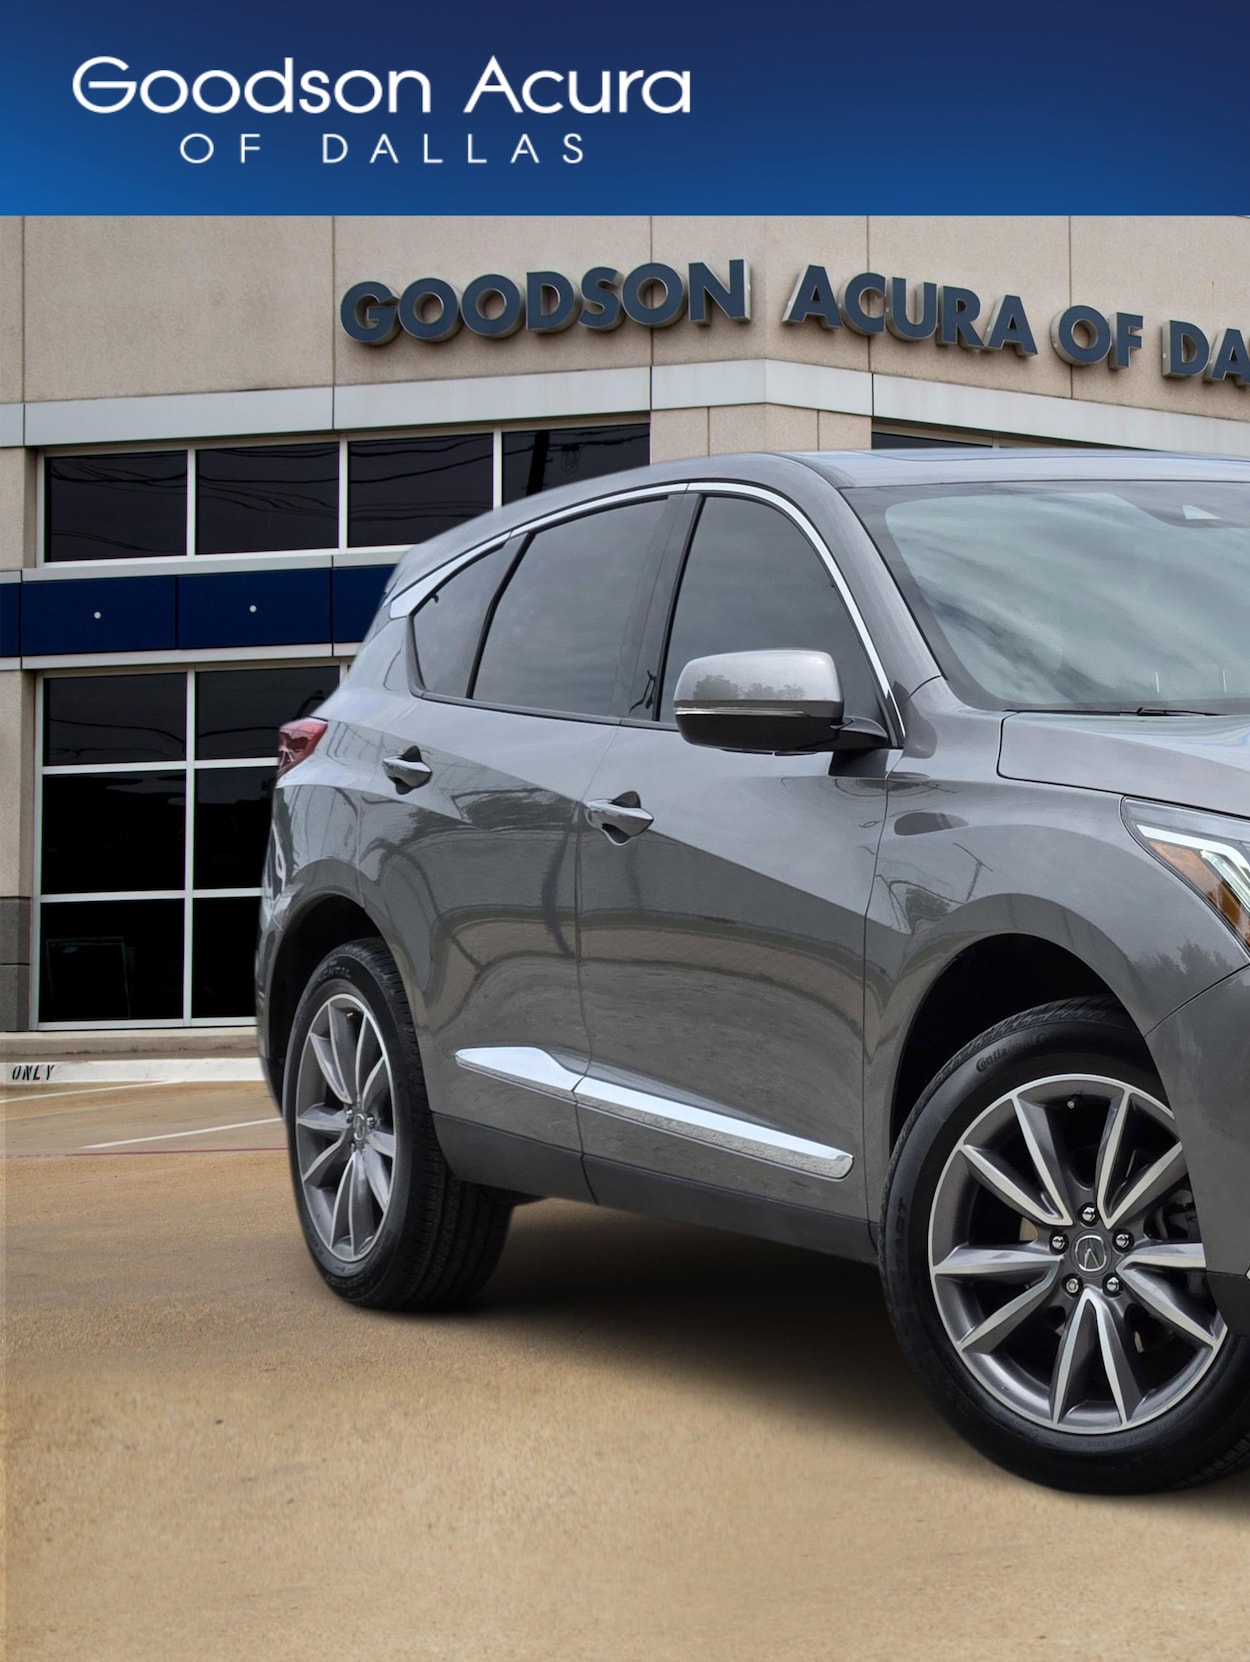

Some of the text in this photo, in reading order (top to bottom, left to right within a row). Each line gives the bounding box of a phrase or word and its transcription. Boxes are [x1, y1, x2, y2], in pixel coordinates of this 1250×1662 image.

[340, 259, 750, 345] GOODSON
[783, 265, 1038, 356] ACURA
[1051, 304, 1144, 368] OF
[12, 1065, 55, 1080] ONLY
